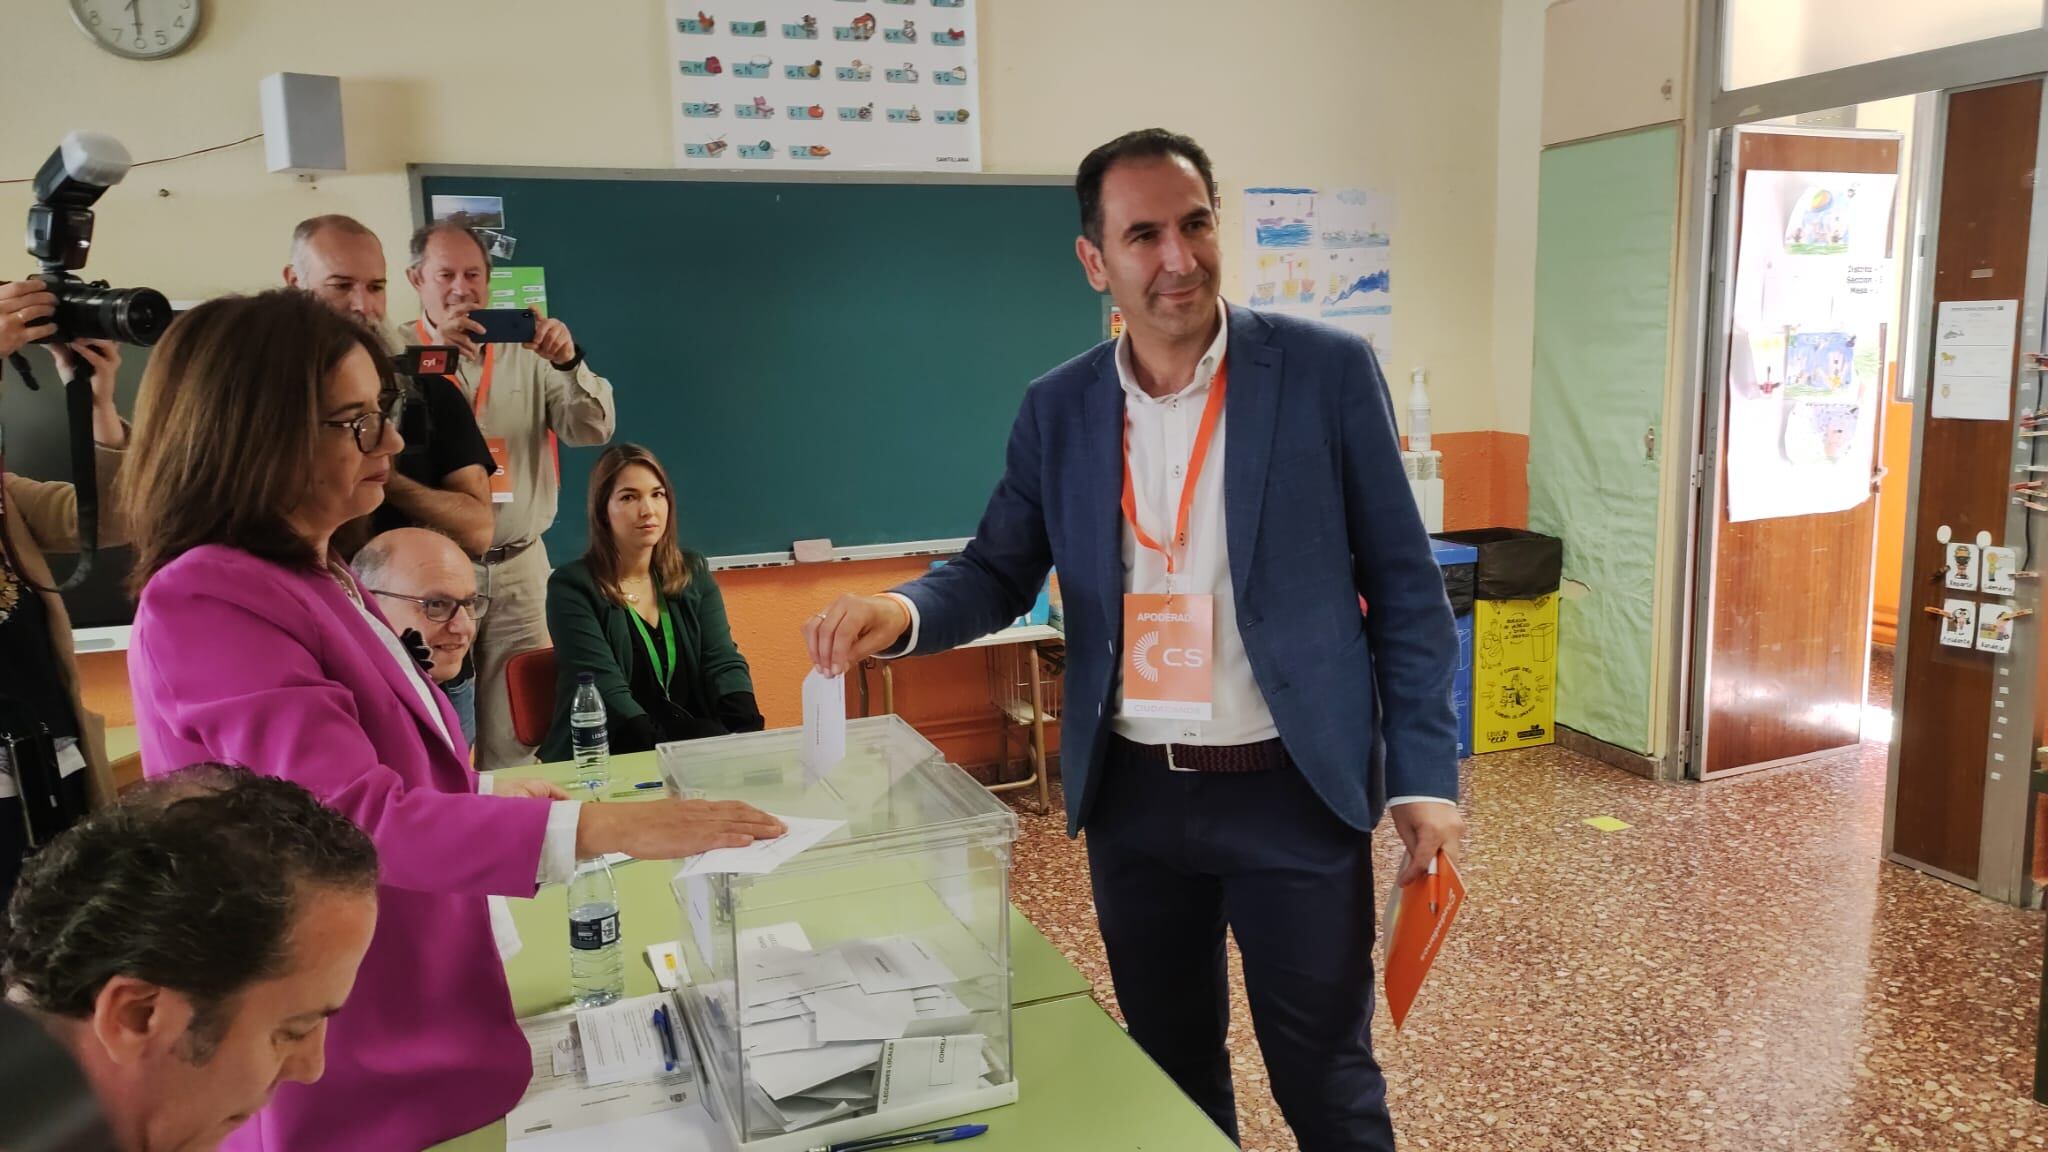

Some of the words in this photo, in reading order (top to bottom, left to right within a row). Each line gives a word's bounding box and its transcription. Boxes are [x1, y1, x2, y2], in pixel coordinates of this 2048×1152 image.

[173, 15, 185, 28] 4
[112, 27, 123, 43] 7
[154, 30, 167, 45] 5
[1136, 612, 1193, 622] APODERAD
[1163, 647, 1203, 668] CS
[886, 1042, 895, 1069] LOCALES
[882, 1069, 891, 1105] ELECCIONES
